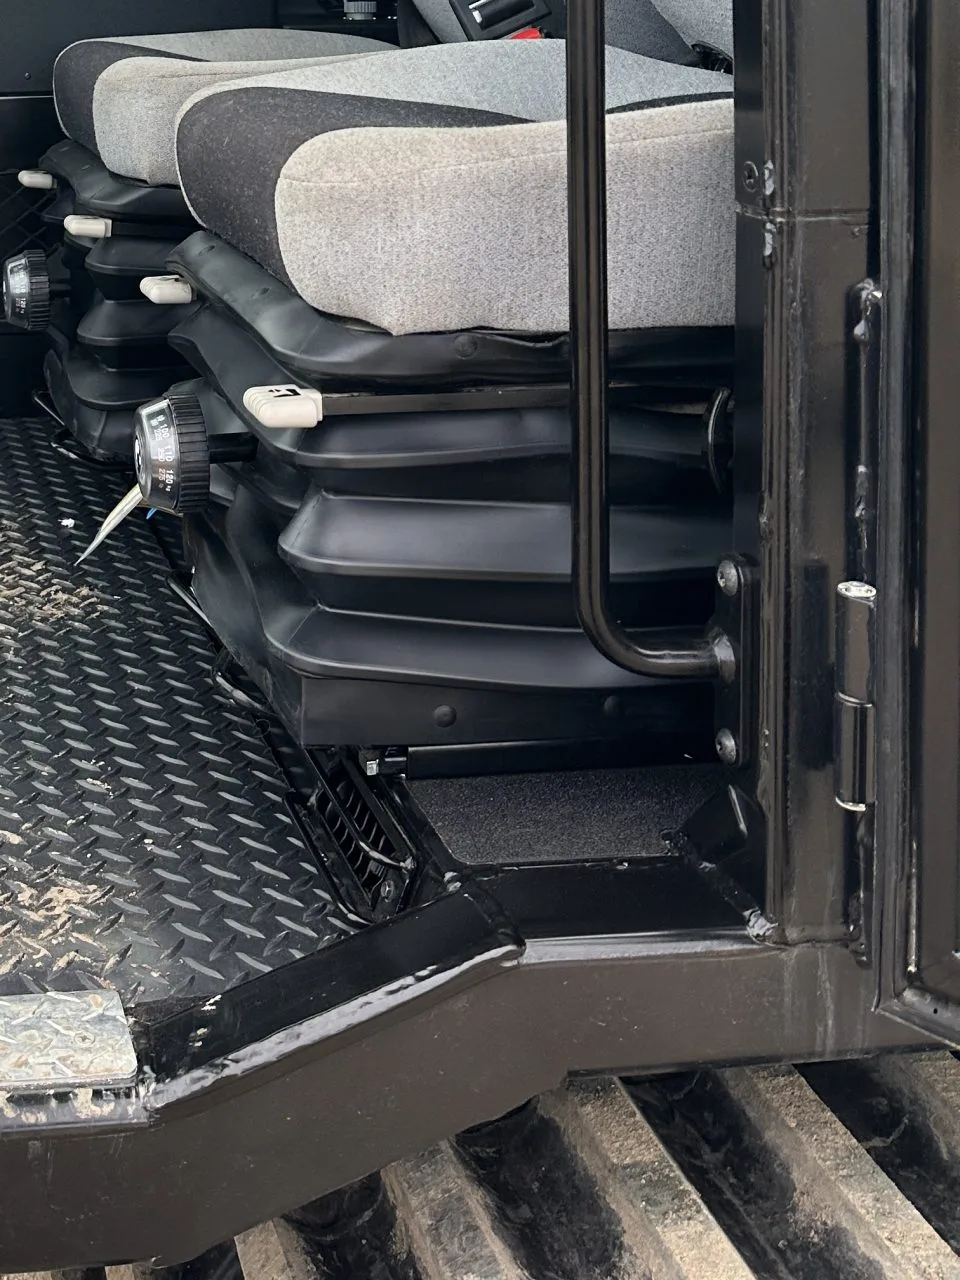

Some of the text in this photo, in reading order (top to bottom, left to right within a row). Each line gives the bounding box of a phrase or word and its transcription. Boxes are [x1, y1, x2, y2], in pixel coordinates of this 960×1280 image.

[160, 423, 170, 439] 100
[164, 446, 173, 462] 110
[166, 469, 174, 484] 120
